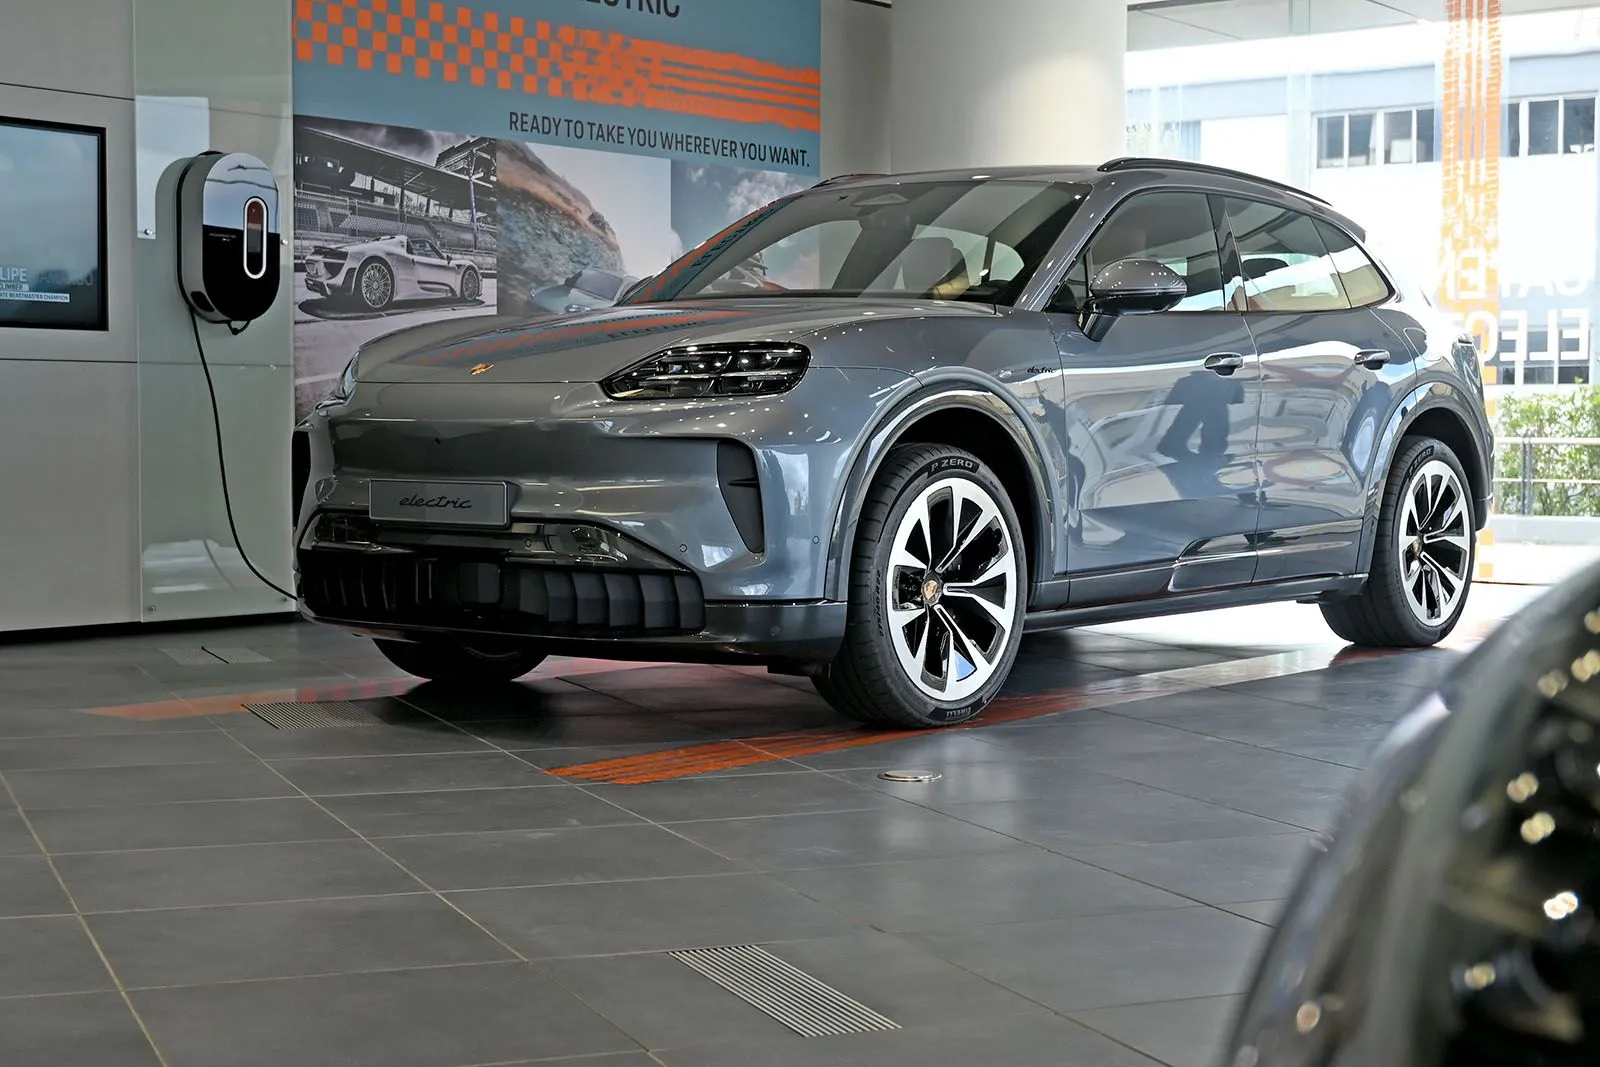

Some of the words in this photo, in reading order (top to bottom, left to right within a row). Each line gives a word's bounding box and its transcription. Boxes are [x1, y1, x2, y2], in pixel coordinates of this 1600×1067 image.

[509, 111, 562, 137] READY
[564, 119, 584, 139] TO
[587, 122, 625, 145] TAKE
[627, 127, 657, 148] YOU
[660, 131, 738, 158] WHEREVER
[739, 141, 767, 162] YOU
[769, 146, 810, 168] WANT.
[931, 462, 939, 471] P
[941, 458, 973, 469] ZERO
[399, 494, 472, 509] electric
